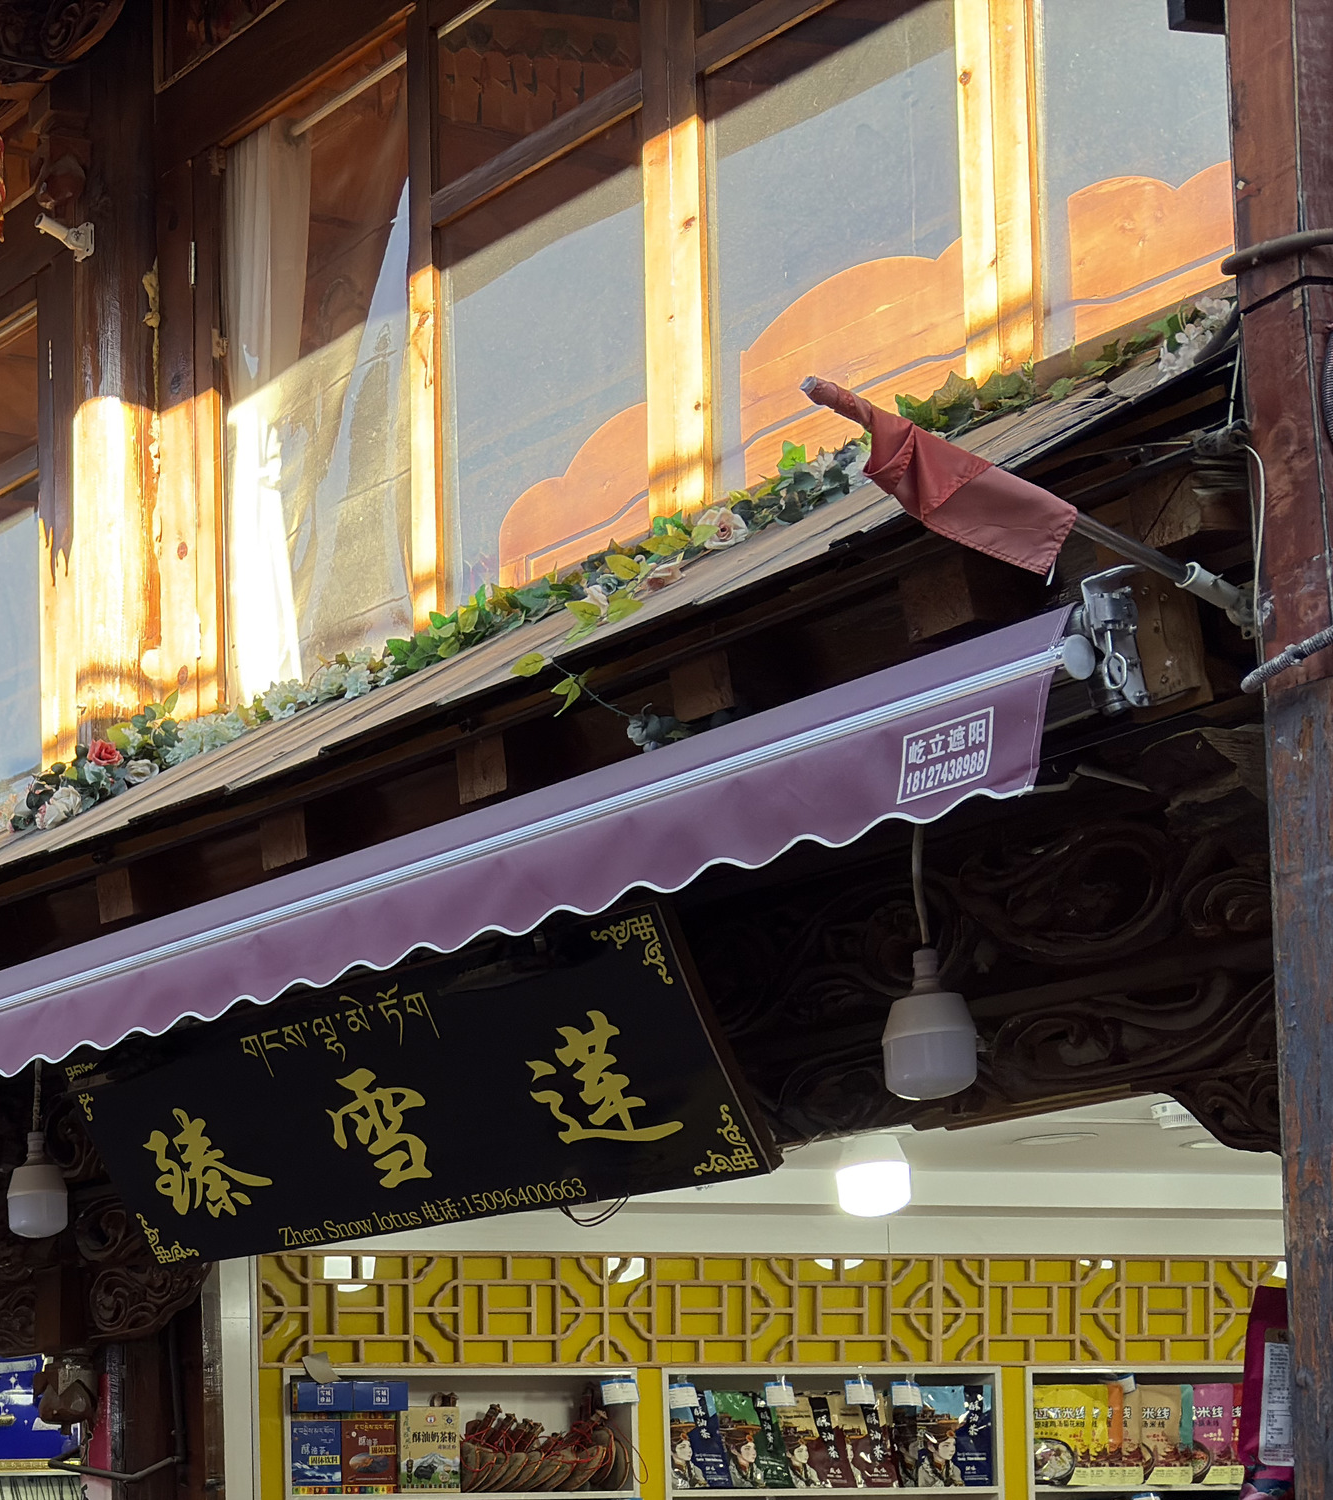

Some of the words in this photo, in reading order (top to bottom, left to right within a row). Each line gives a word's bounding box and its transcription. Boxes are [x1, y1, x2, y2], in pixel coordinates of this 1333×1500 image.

[907, 718, 987, 764] 屹立遮阳
[906, 749, 985, 794] 18127438988
[279, 1227, 324, 1248] Zhen
[323, 1219, 373, 1240] Snow
[372, 1211, 422, 1232] lotus
[412, 1431, 457, 1444] 酥油奶茶粉
